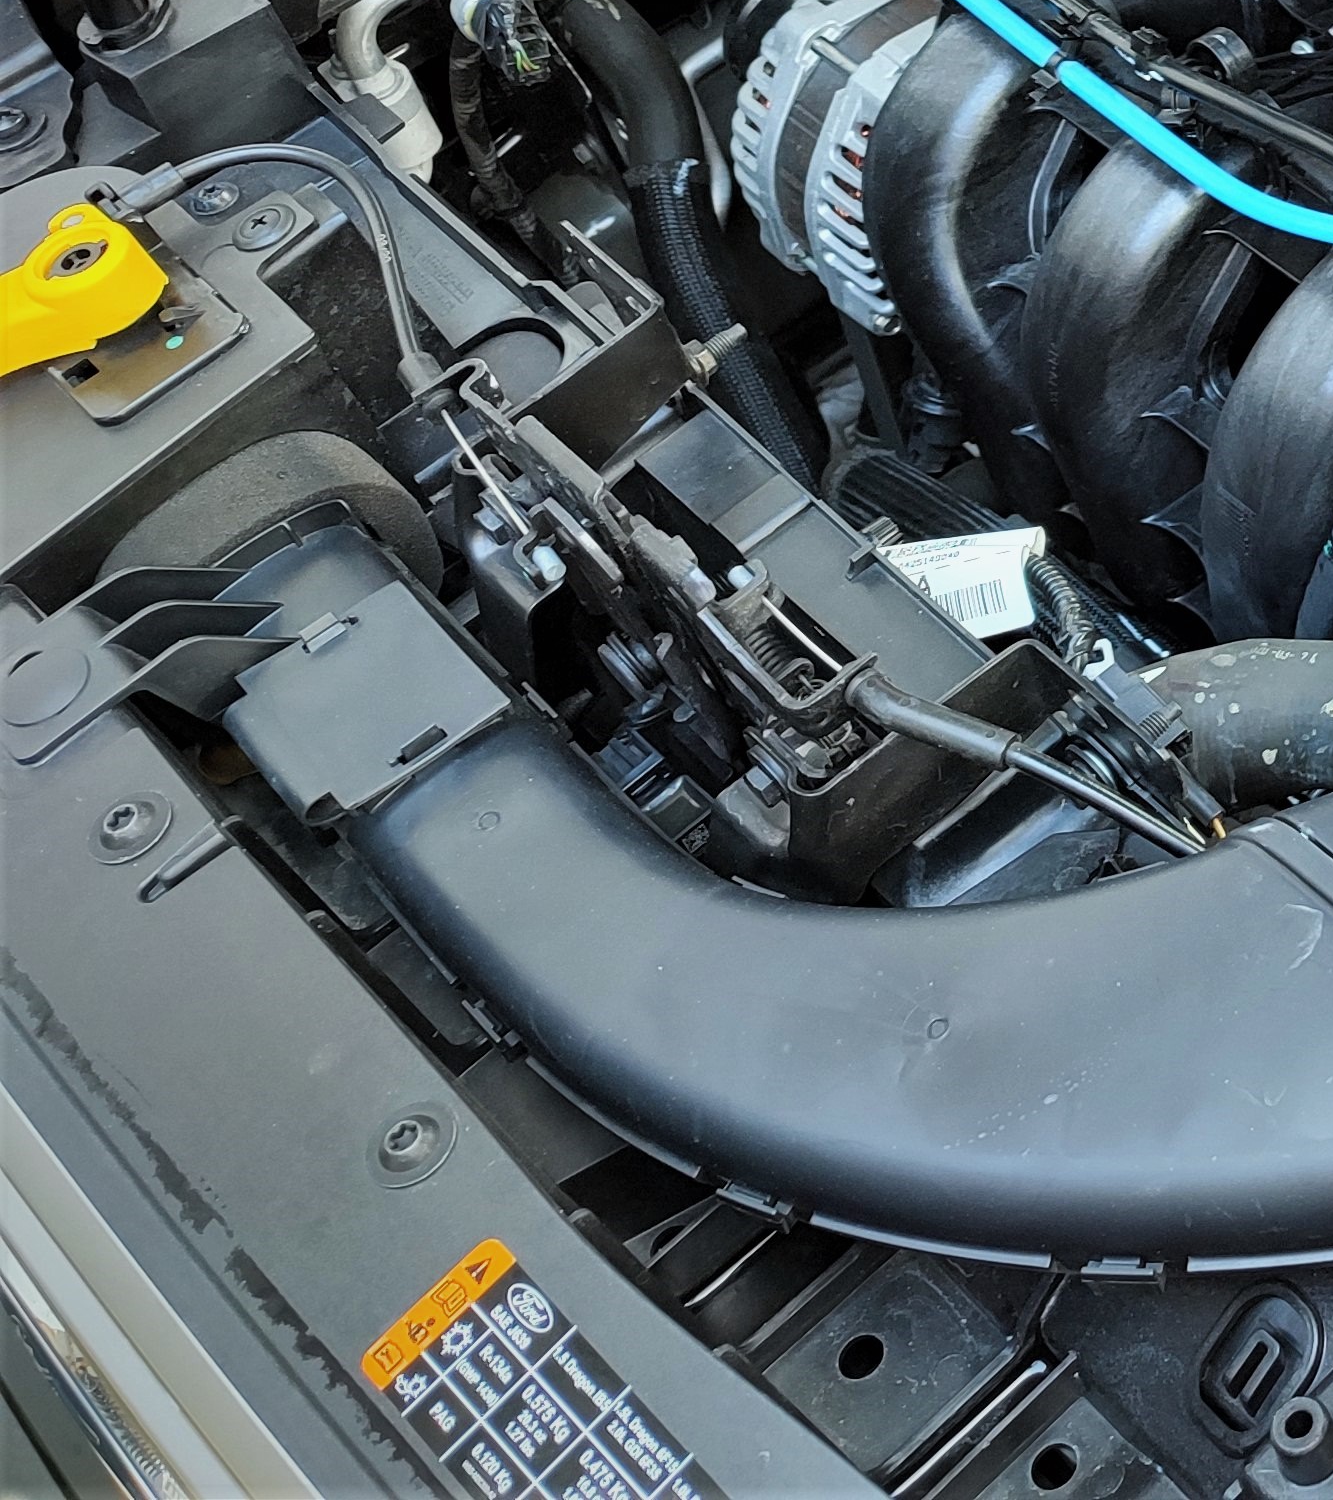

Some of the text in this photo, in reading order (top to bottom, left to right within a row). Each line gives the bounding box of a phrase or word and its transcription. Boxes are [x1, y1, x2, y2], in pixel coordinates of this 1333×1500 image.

[490, 1303, 514, 1330] SAE
[510, 1288, 551, 1329] Ford
[428, 1400, 456, 1433] PAG
[521, 1384, 572, 1445] 0.575 Kg
[493, 1467, 514, 1494] Kg
